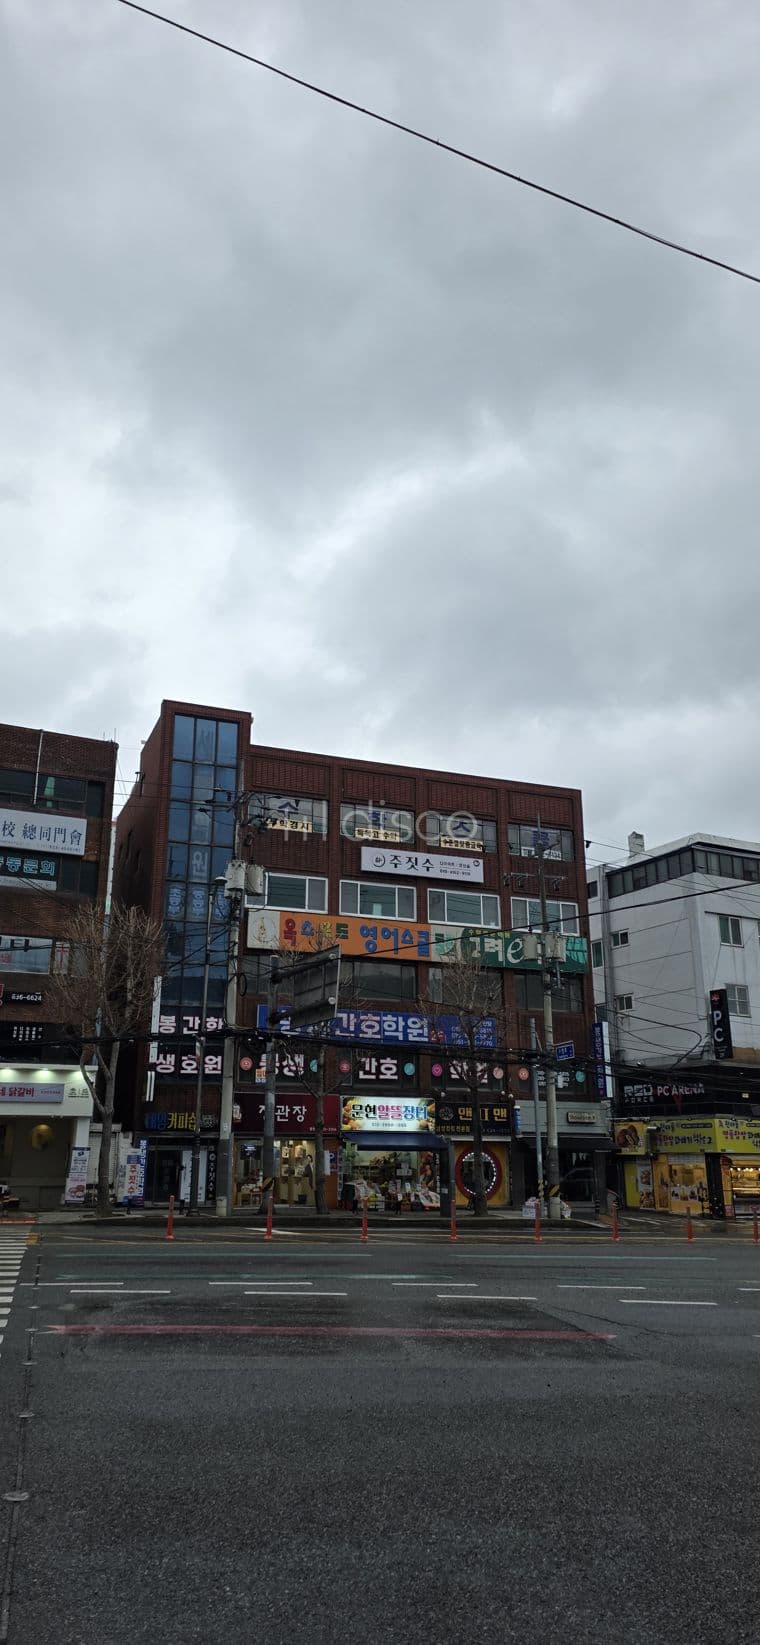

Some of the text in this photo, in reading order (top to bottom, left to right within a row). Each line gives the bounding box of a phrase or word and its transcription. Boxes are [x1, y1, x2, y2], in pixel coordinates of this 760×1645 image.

[0, 856, 55, 876] 동문회
[390, 855, 434, 872] 주짓수
[360, 925, 430, 957] 영어스쿨
[335, 1012, 429, 1042] 간호학원
